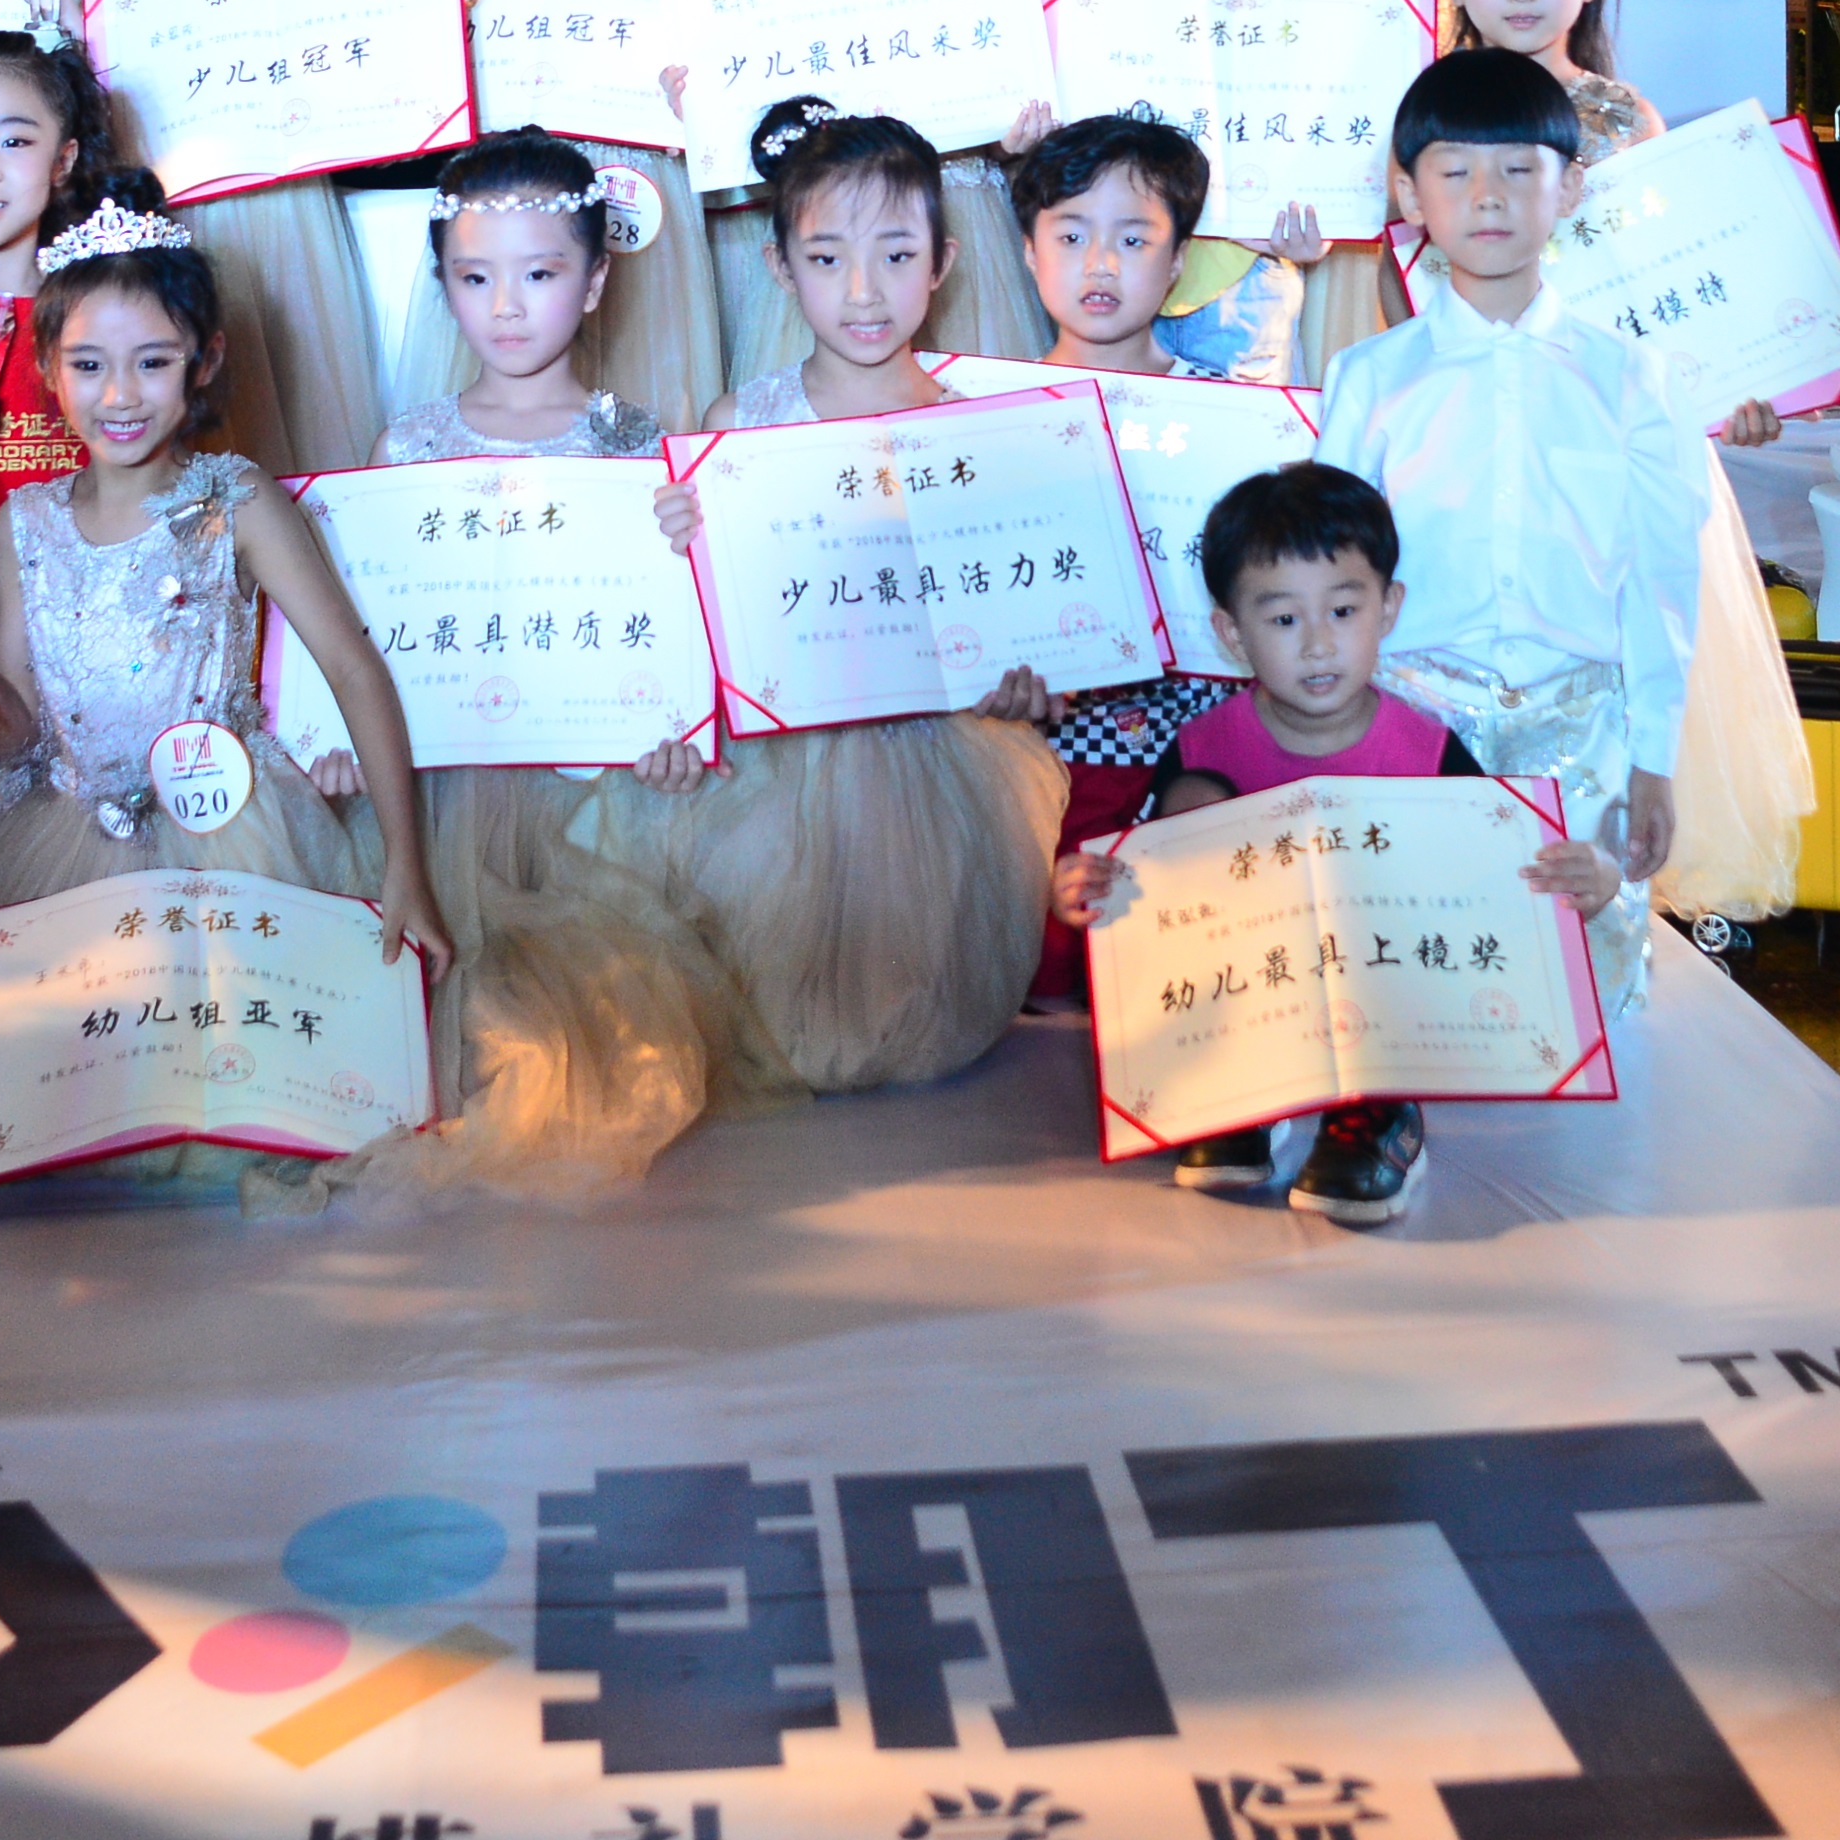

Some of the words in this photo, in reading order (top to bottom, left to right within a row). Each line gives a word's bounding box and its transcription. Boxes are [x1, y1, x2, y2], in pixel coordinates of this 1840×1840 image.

[722, 18, 1003, 89] 少儿最佳风采奖
[1175, 14, 1301, 48] 荣誉证书
[186, 36, 372, 101] 少儿组冠军
[836, 455, 977, 502] 荣誉证书
[417, 503, 567, 543] 荣誉证书
[781, 546, 1087, 617] 少儿最具活力奖
[363, 610, 657, 656] 儿最具潜质奖
[174, 788, 229, 819] 020
[1228, 821, 1392, 881] 荣誉证书
[114, 905, 281, 940] 荣誉证书
[1160, 931, 1508, 1014] 幼儿最具上镜奖
[81, 996, 323, 1044] 幼儿组亚军
